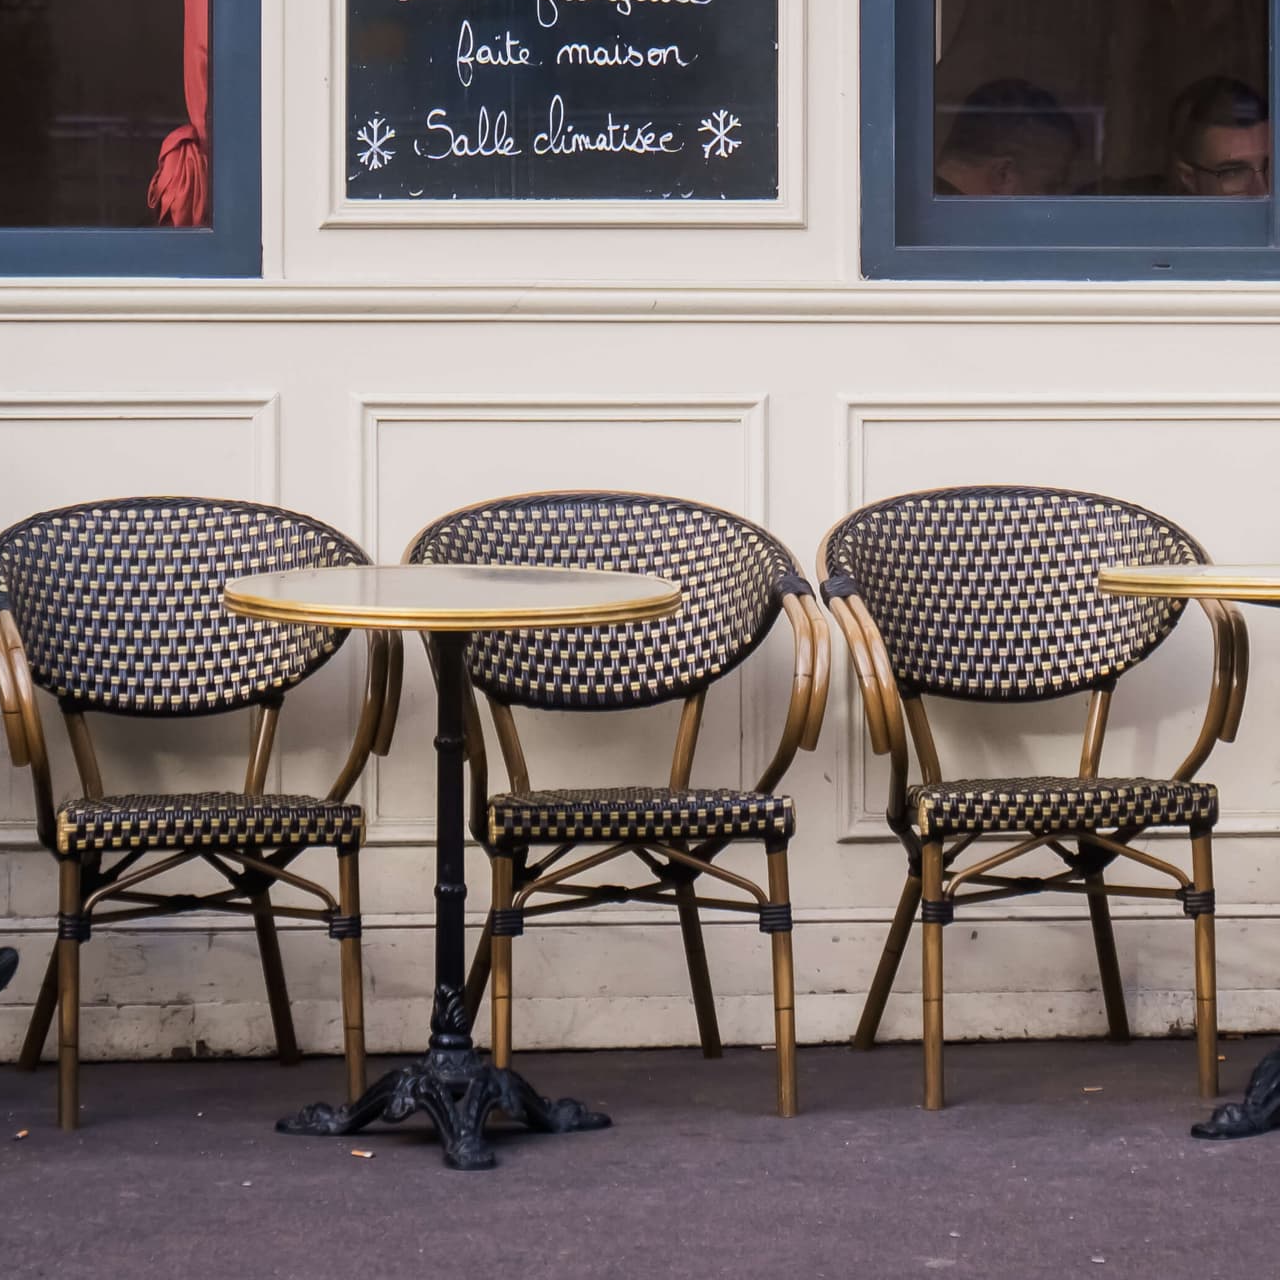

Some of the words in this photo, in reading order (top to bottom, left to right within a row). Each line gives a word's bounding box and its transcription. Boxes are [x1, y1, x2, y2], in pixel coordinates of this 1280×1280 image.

[456, 19, 543, 88] faite
[556, 35, 699, 68] maison
[413, 105, 523, 160] Salle
[533, 94, 686, 155] climatisée
